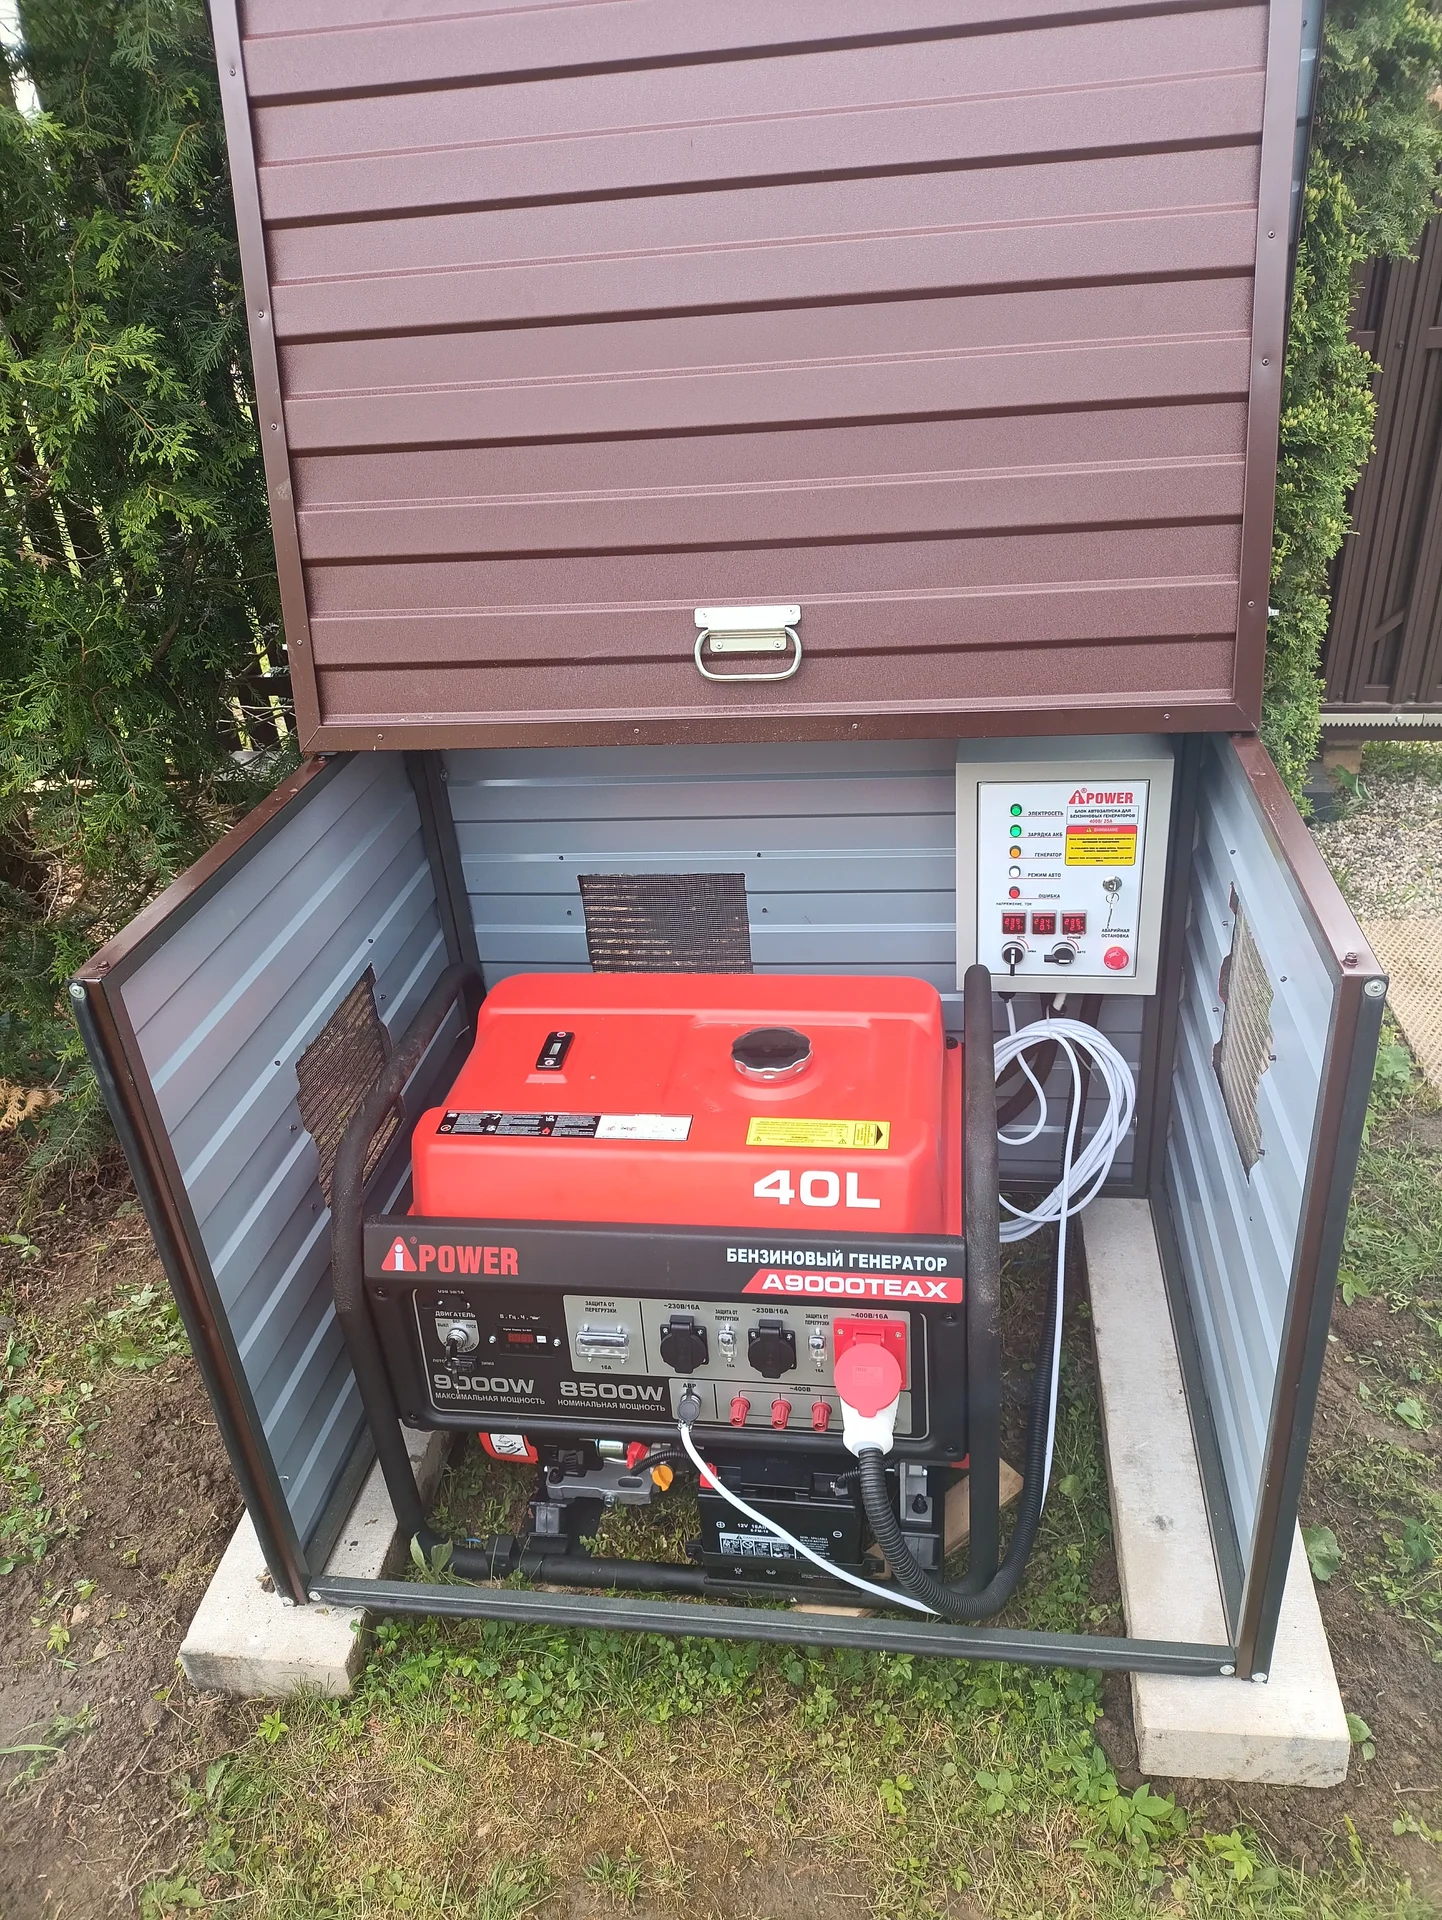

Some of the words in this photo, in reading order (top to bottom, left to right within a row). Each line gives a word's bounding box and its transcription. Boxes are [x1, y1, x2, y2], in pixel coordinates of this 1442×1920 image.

[754, 1170, 881, 1209] 40L
[727, 1248, 844, 1267] БЕНЗИНОВЫЙ
[849, 1253, 948, 1272] ГЕНЕРАТОР
[762, 1274, 948, 1299] A9000TEAX
[435, 1392, 498, 1403] МАКСИМАЛЬНАЯ
[499, 1395, 545, 1405] МОЩНОСТЬ
[560, 1381, 663, 1401] 8500W
[558, 1399, 618, 1409] НОМИНАЛЬНАЯ
[619, 1402, 666, 1412] МОЩНОСТЬ
